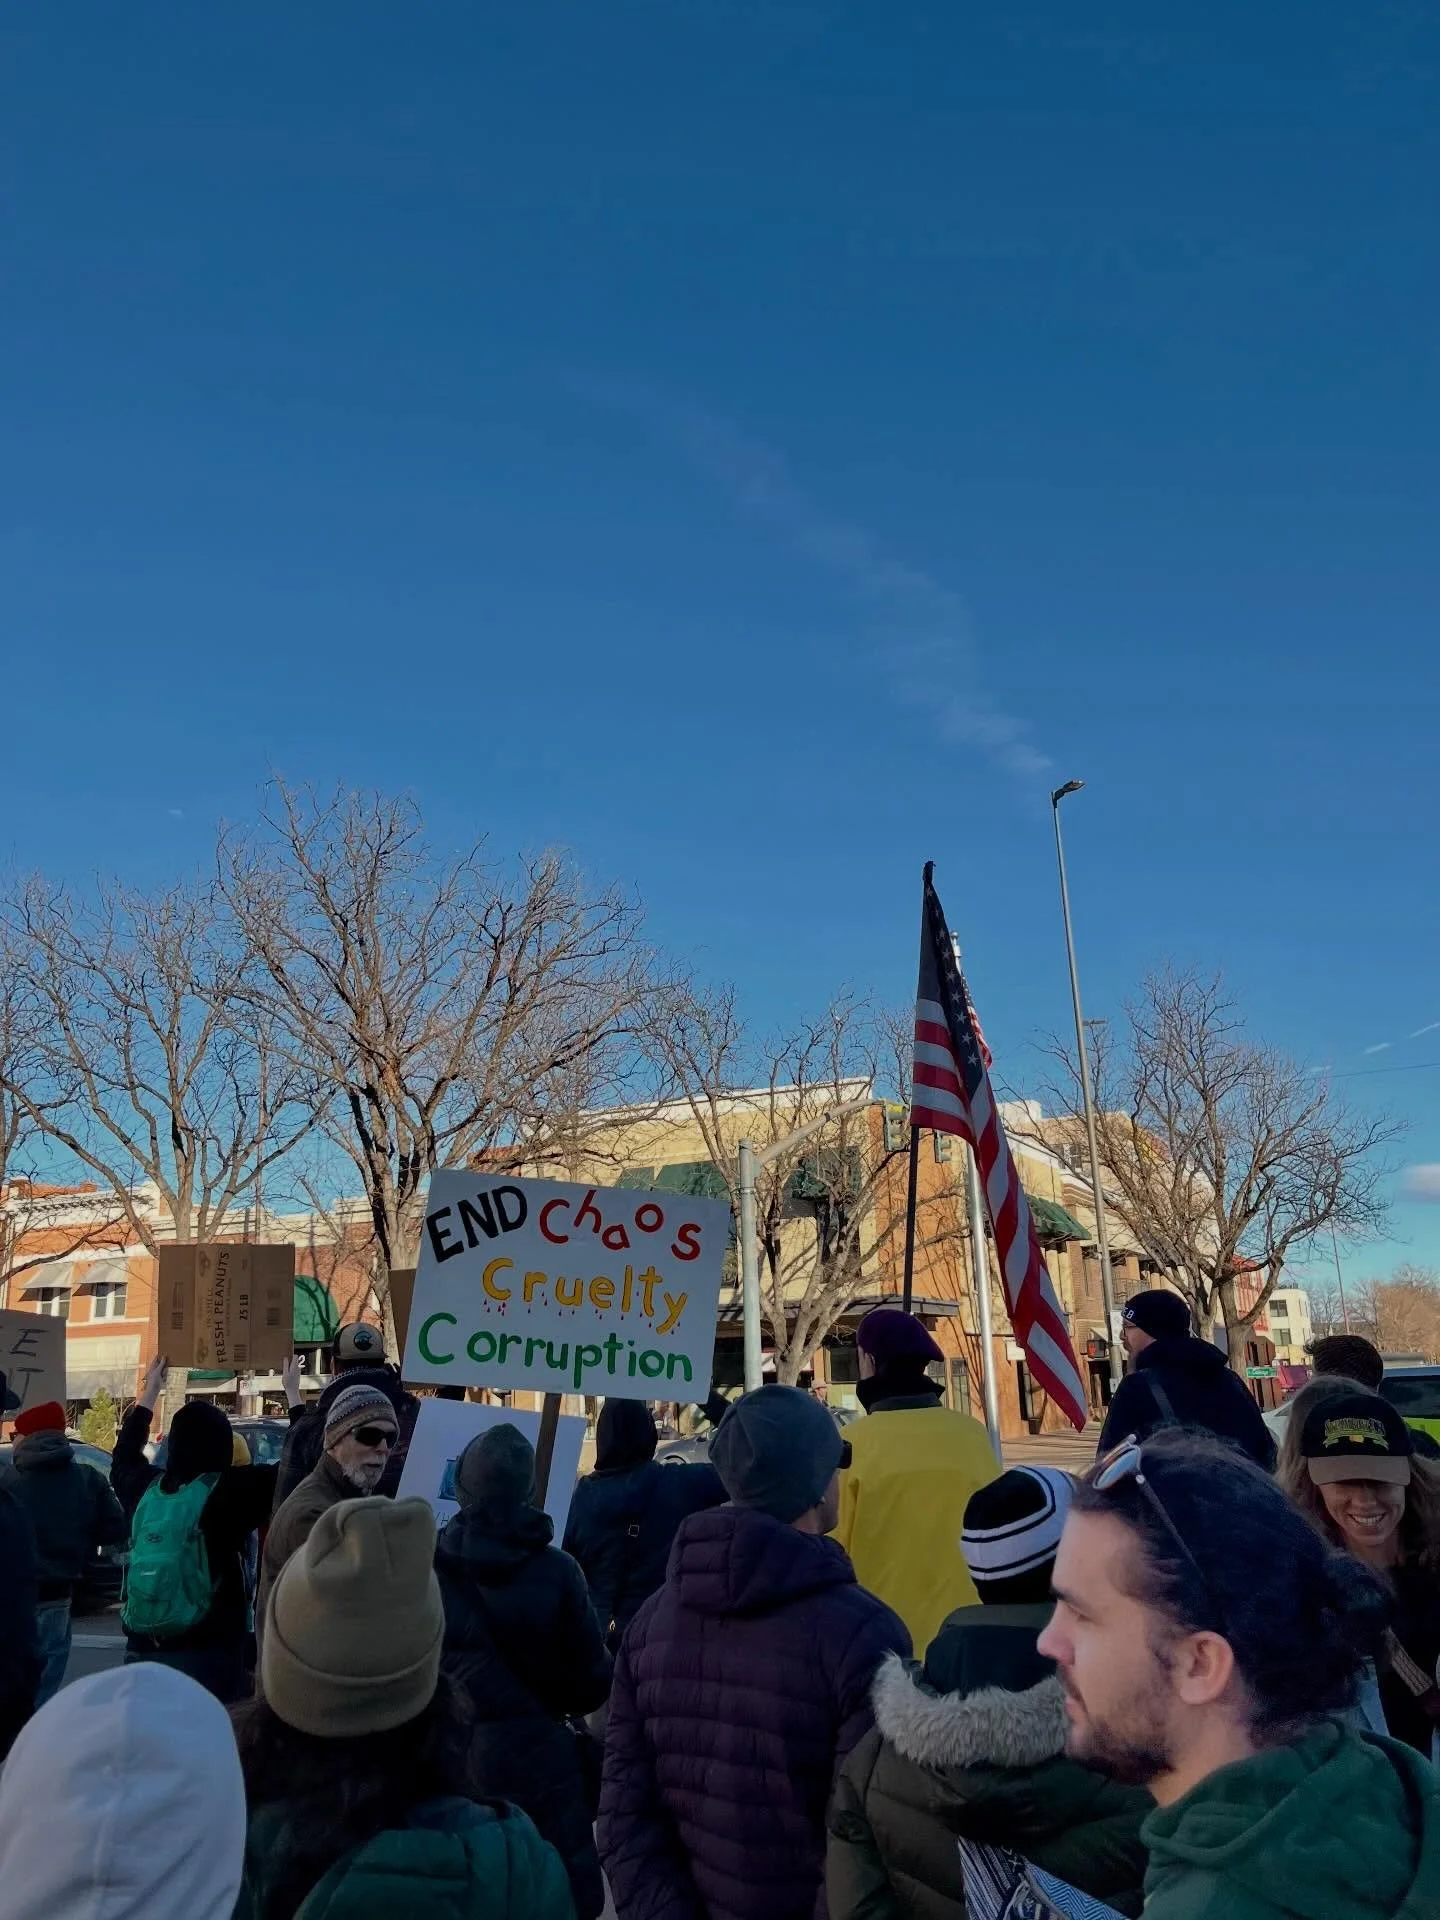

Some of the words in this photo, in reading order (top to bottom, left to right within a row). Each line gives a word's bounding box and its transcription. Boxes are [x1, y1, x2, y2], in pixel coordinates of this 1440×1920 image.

[426, 1185, 528, 1263] END
[540, 1189, 701, 1260] Chaos
[214, 1252, 230, 1314] PEANUTS
[239, 1294, 249, 1306] LB
[239, 1308, 248, 1320] 25
[482, 1257, 688, 1334] Cruelty
[215, 1321, 227, 1363] FRESH
[418, 1312, 693, 1389] Corruption
